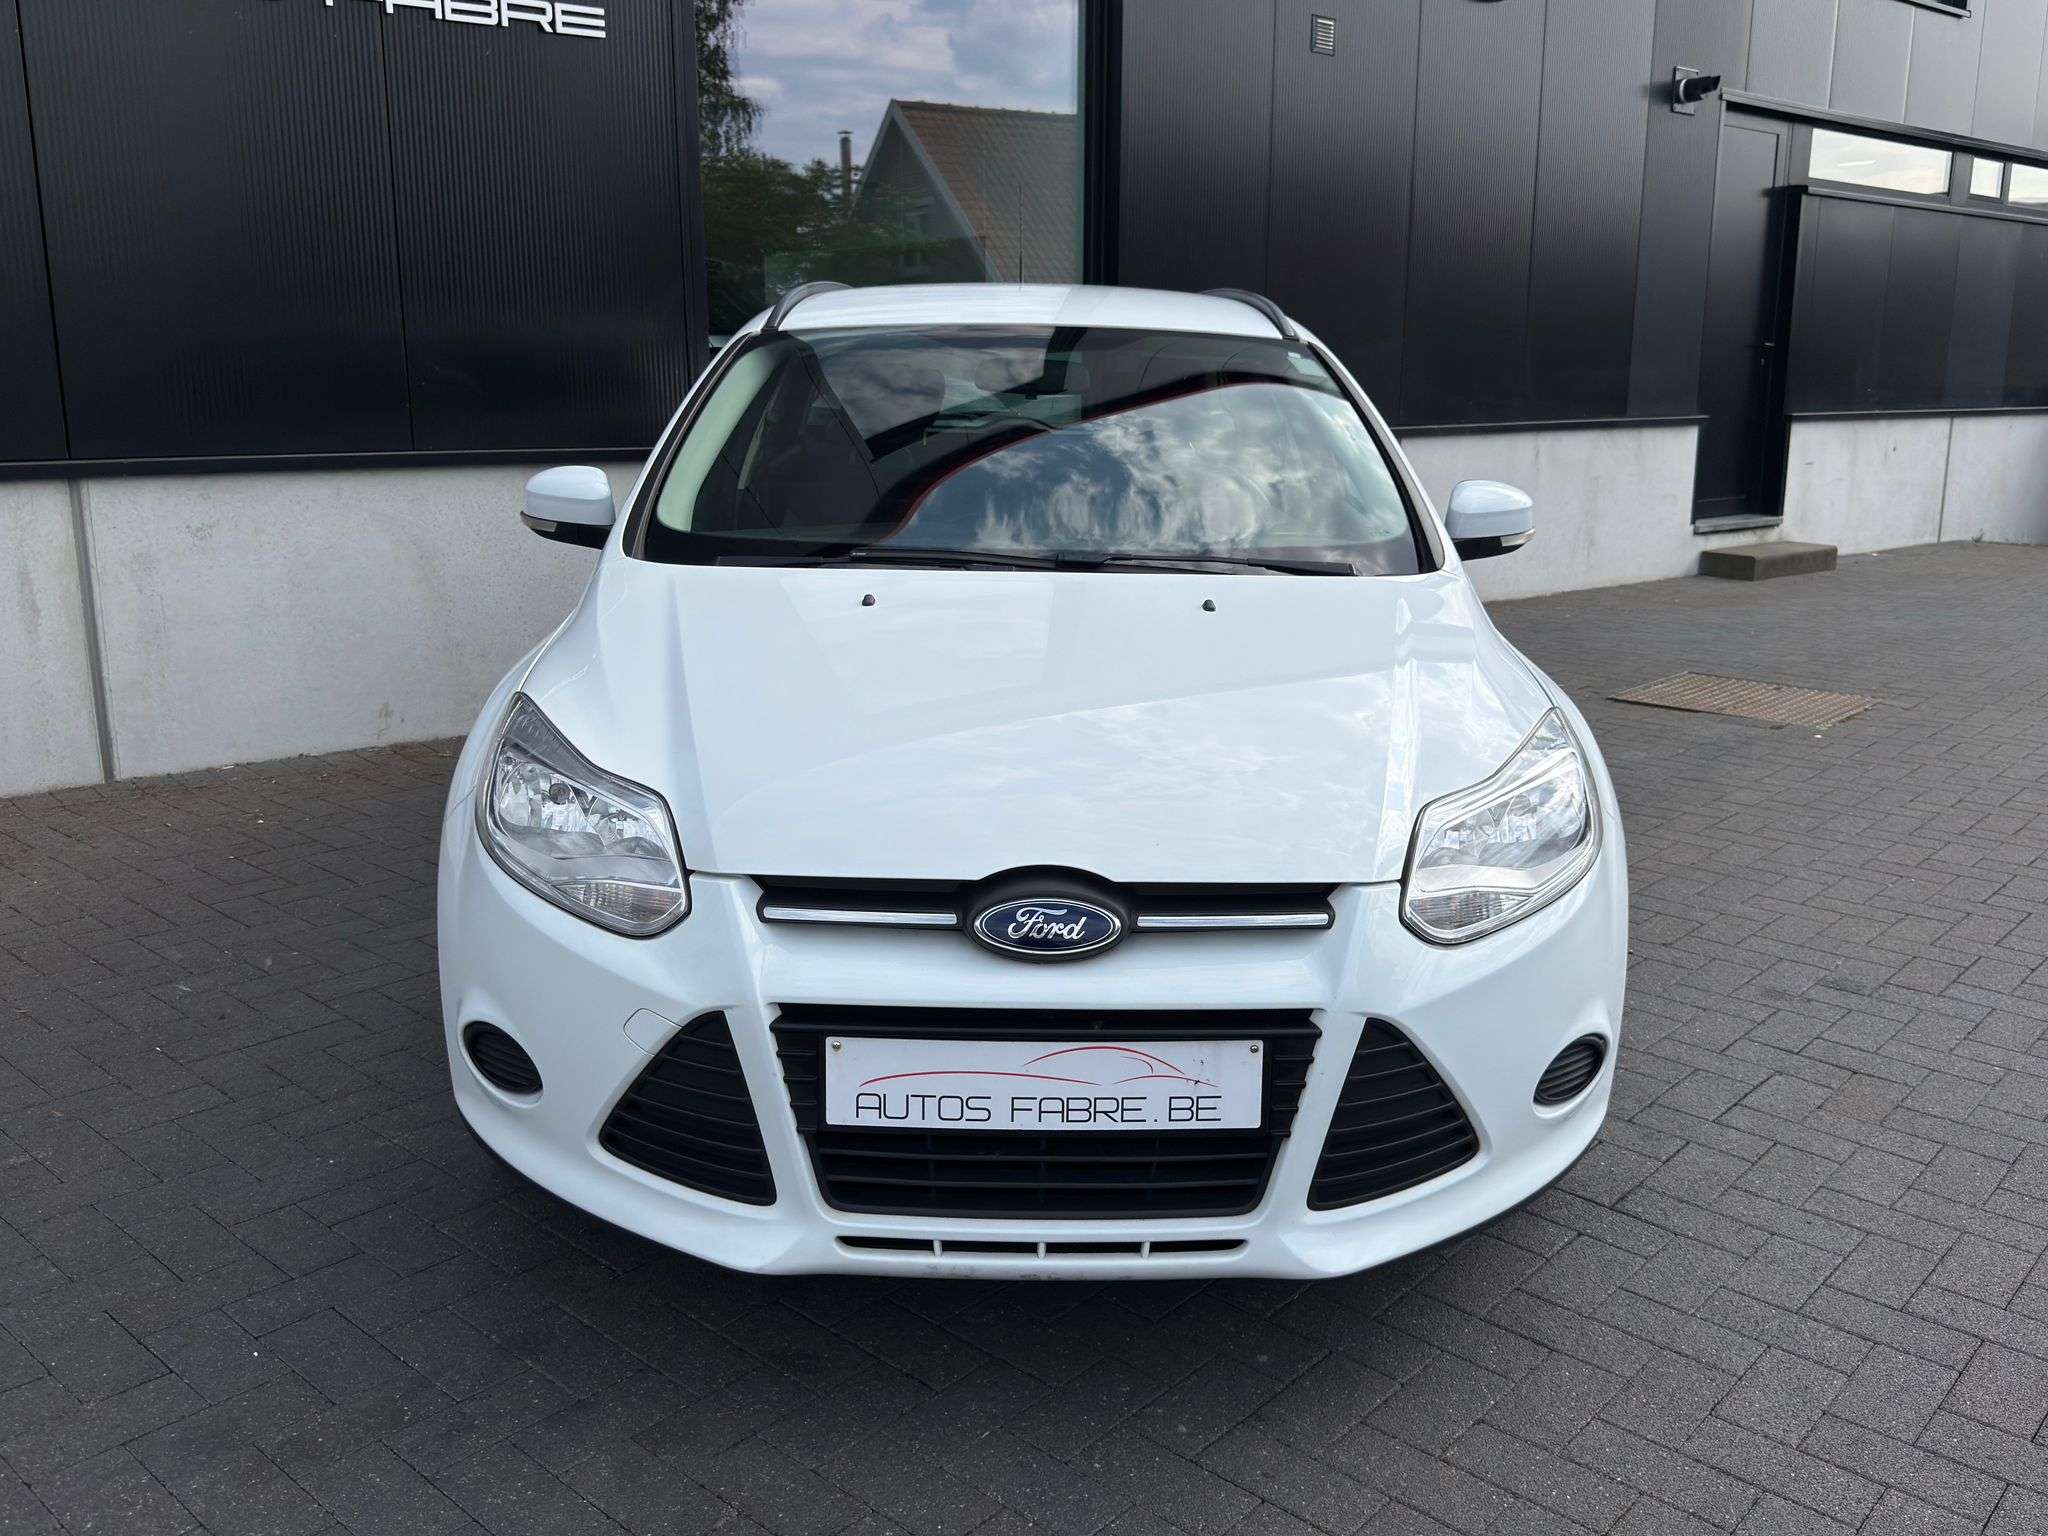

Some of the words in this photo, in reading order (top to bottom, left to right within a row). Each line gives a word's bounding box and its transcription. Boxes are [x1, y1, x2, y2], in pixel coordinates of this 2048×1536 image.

[325, 0, 606, 38] ABRE
[1007, 907, 1087, 940] Ford
[856, 1092, 992, 1122] AUTOS
[1010, 1095, 1222, 1123] FABRE.BE
